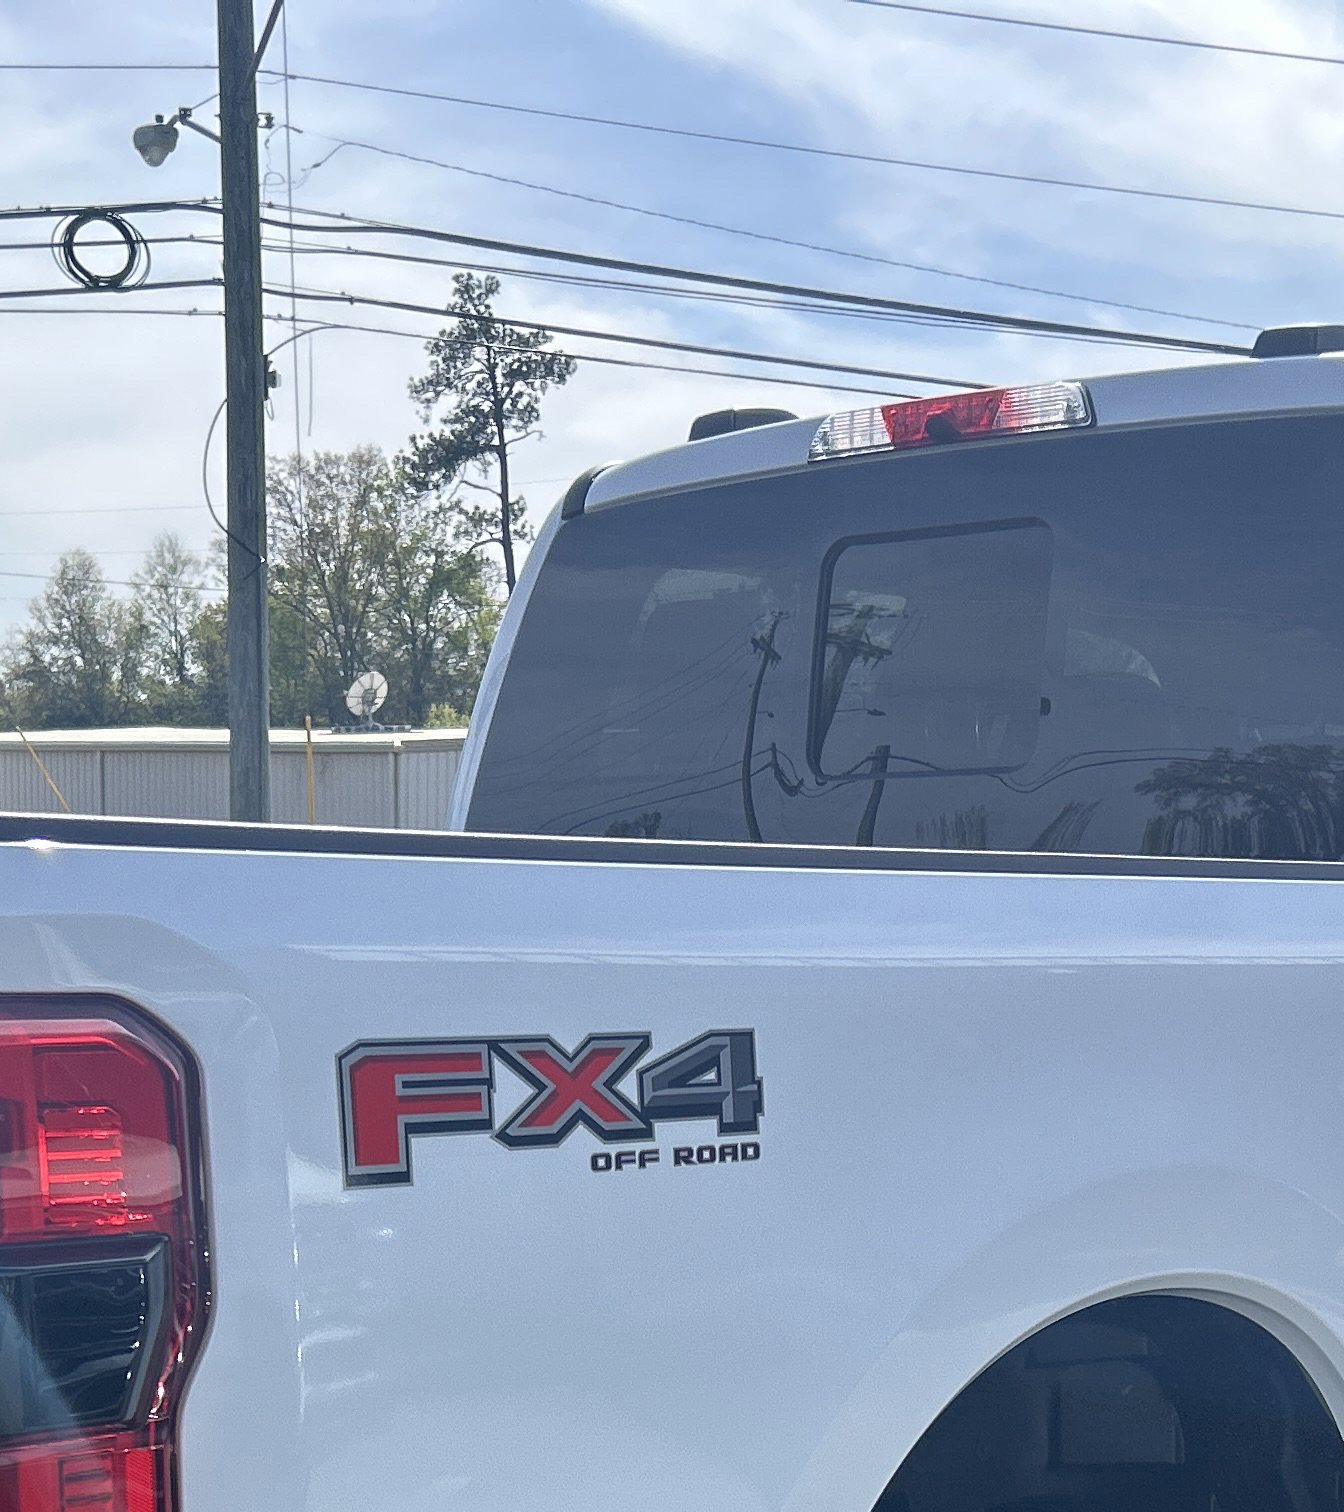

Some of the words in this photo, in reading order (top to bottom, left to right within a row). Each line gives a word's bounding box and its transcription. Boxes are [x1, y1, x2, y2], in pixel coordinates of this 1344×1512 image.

[335, 1028, 765, 1191] FX4
[591, 1148, 661, 1172] OFF
[672, 1141, 761, 1168] ROAD
